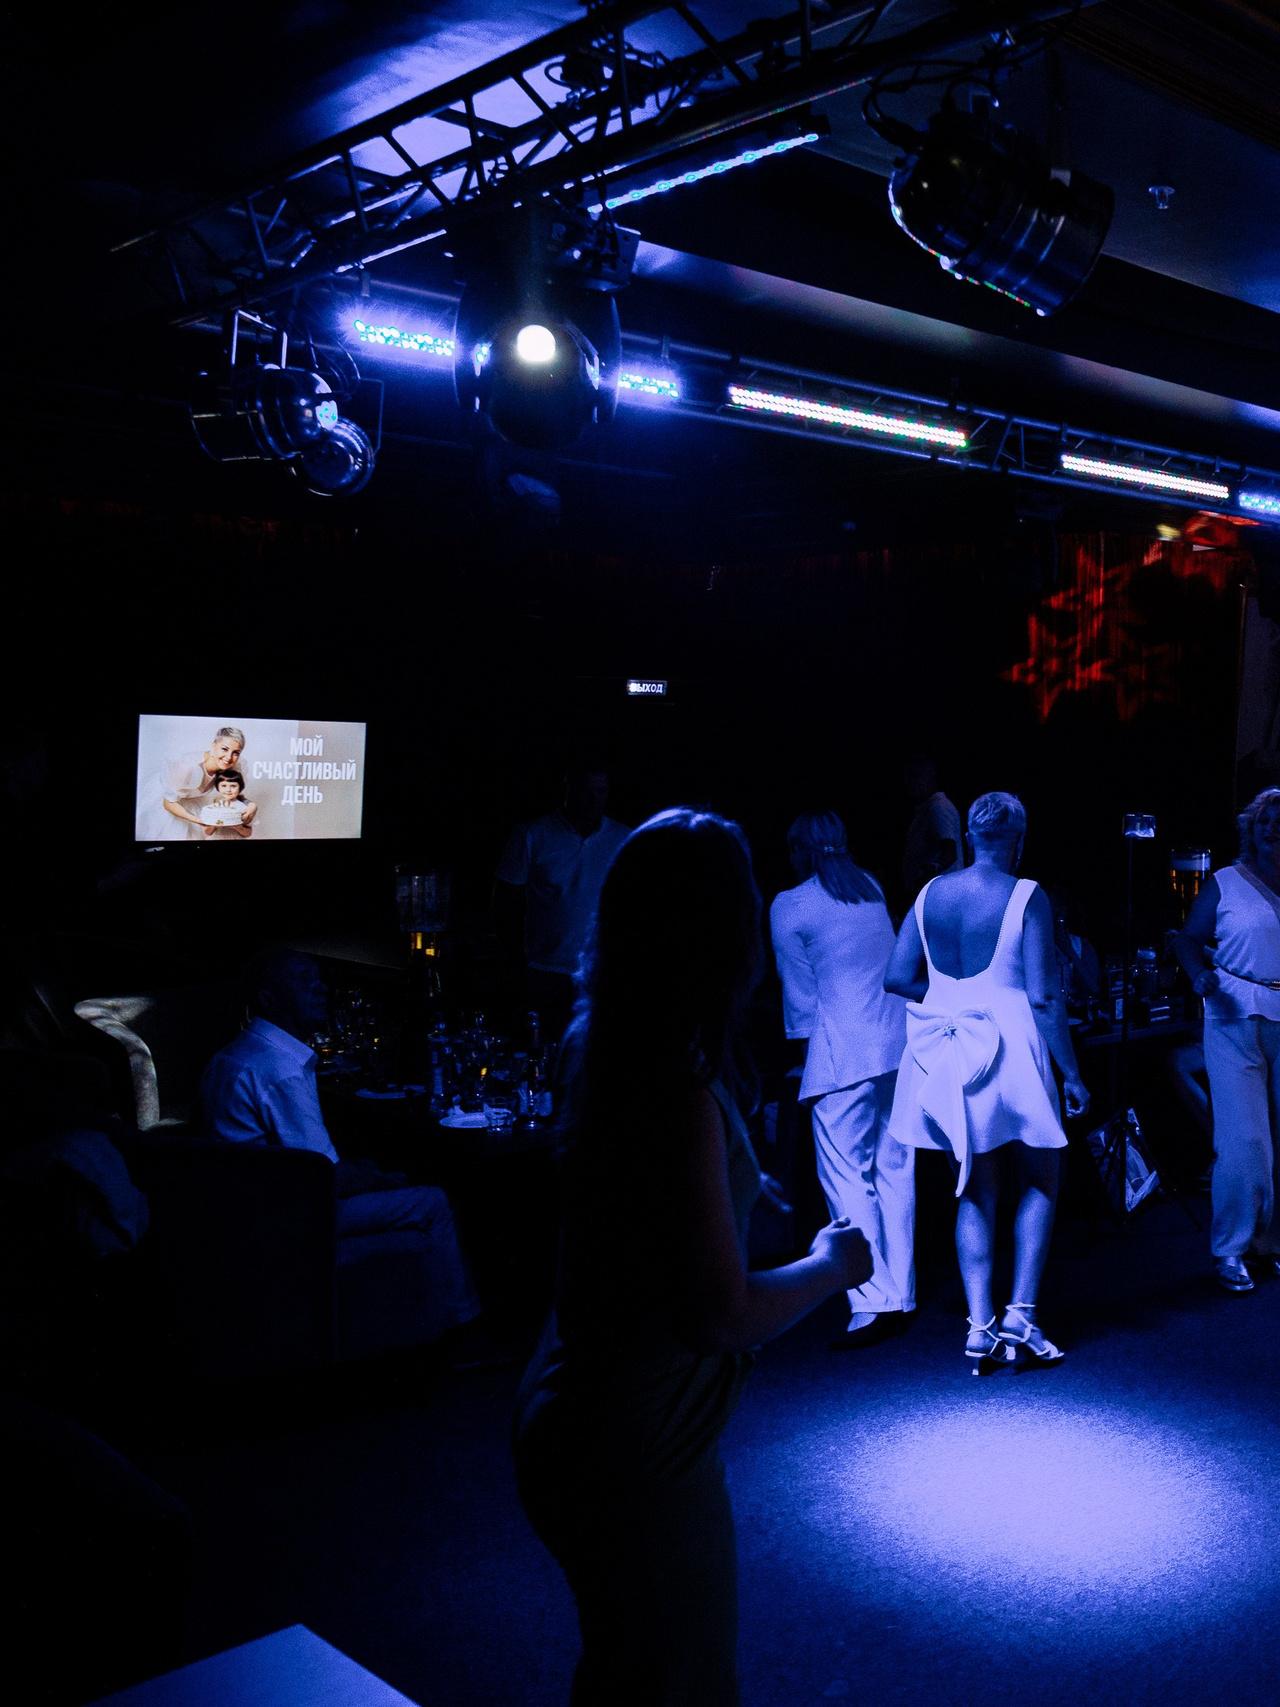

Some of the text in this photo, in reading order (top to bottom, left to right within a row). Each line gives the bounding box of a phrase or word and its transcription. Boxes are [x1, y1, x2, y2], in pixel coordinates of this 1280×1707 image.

[290, 735, 323, 756] МОЙ
[252, 759, 357, 780] СЧАСТЛИВЫЙ
[281, 785, 323, 806] ДЕНЬ
